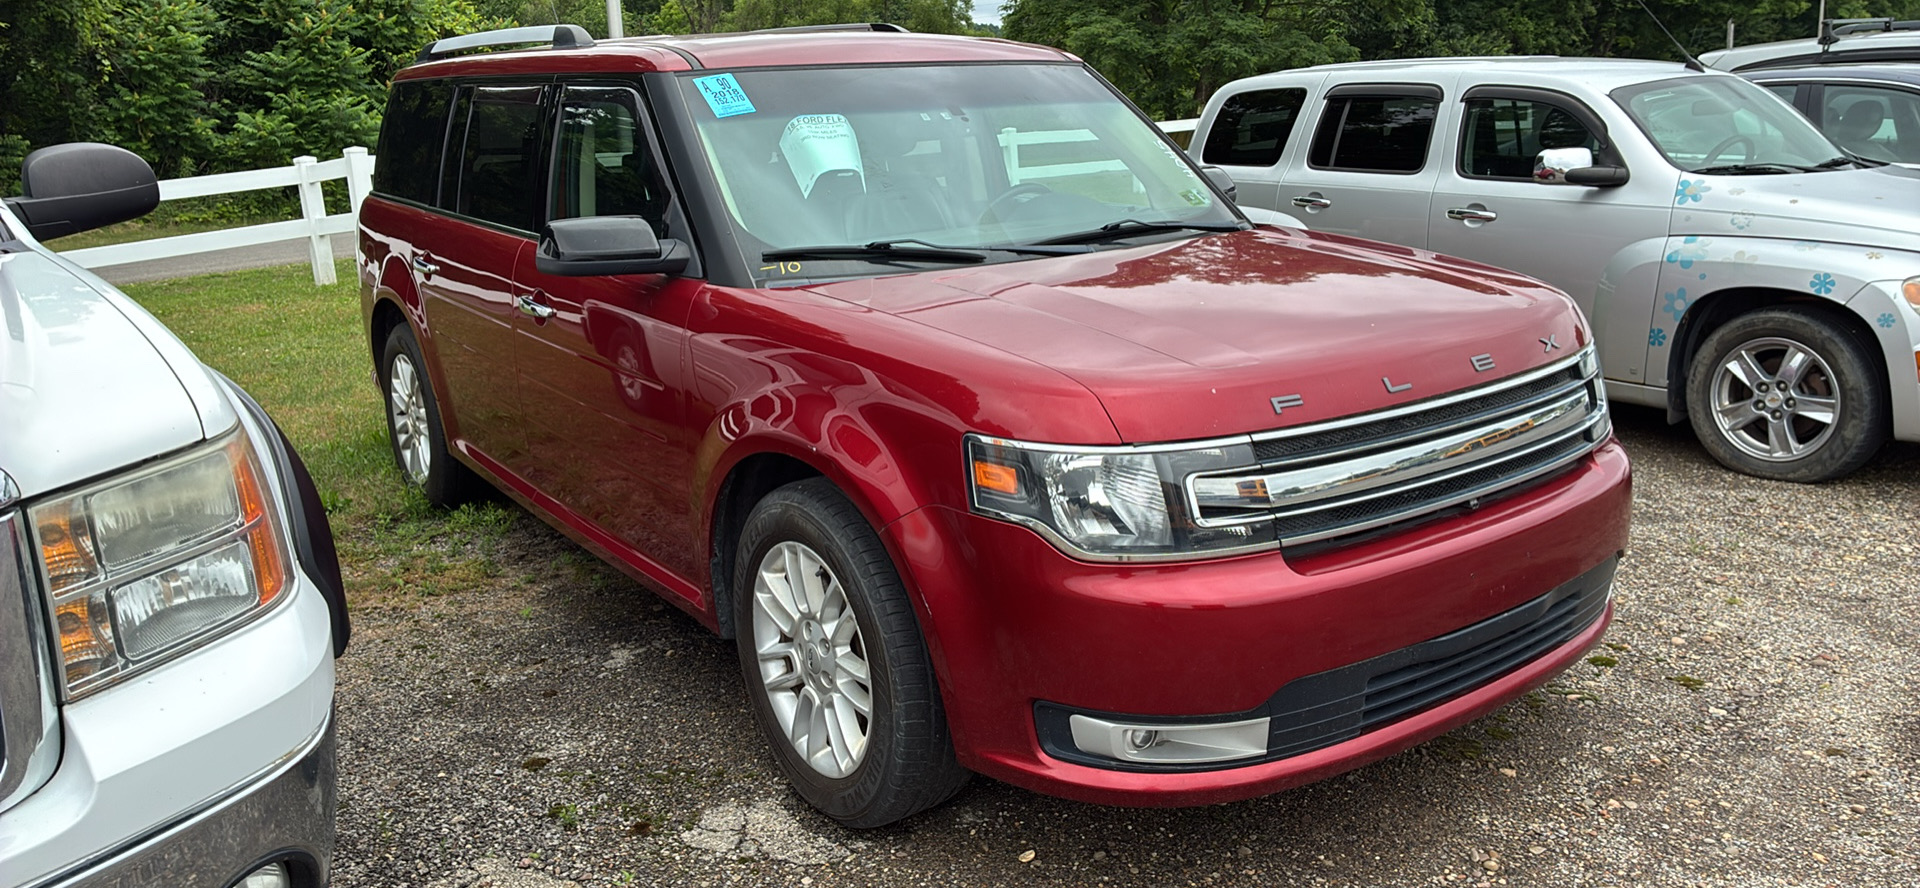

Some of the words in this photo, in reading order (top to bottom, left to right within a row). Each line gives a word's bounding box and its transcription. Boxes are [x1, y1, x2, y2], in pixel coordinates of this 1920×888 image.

[701, 80, 712, 93] A
[716, 77, 732, 90] 90
[711, 88, 740, 99] 2018
[796, 115, 824, 124] FORD
[1271, 334, 1561, 414] FLEX
